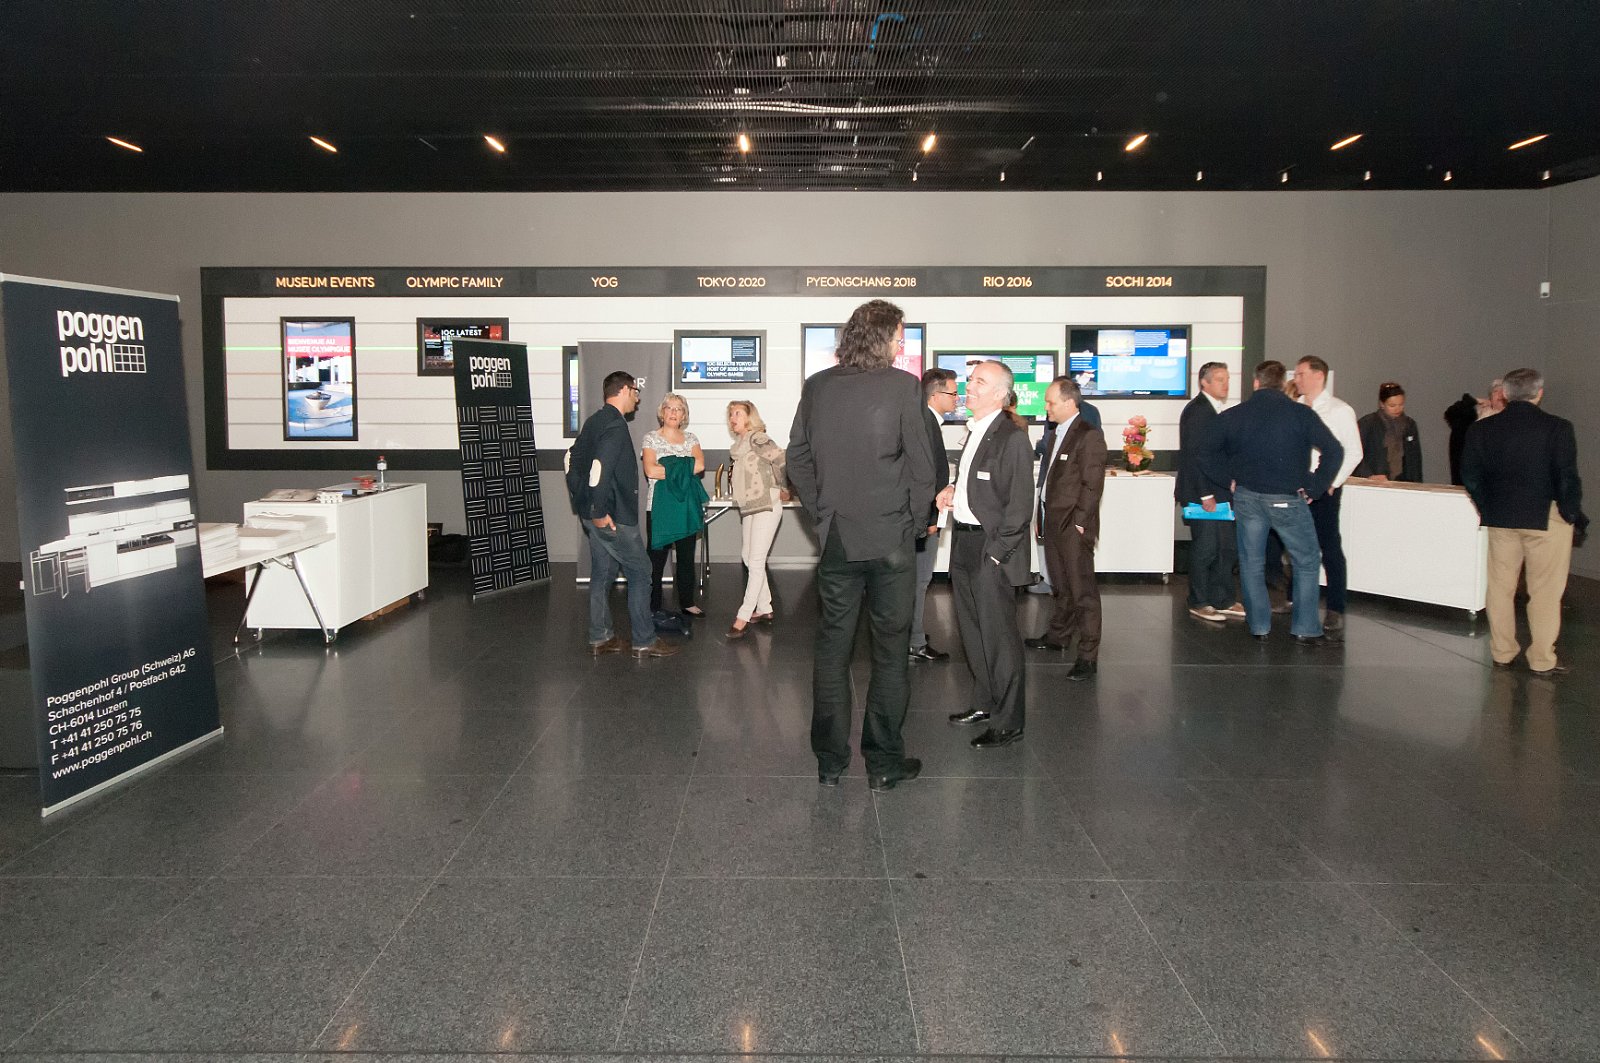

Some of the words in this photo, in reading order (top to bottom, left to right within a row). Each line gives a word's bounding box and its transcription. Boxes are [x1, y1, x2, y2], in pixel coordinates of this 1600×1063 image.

[276, 276, 328, 288] MUSEUM
[330, 276, 376, 288] EVENTS
[406, 276, 460, 288] OLYMPIC
[462, 276, 504, 288] FAMILY
[591, 276, 618, 288] YOG
[697, 276, 736, 288] TOKYO
[738, 276, 766, 288] 2020
[806, 276, 892, 288] PYEONGCHANG
[893, 276, 916, 288] 2018
[983, 276, 1005, 288] RIO
[1006, 276, 1032, 288] 2016
[1106, 276, 1144, 288] SOCHI
[1146, 276, 1172, 288] 2014
[57, 310, 144, 344] poggen
[60, 342, 114, 378] pohl
[469, 356, 511, 372] poggen
[471, 372, 497, 390] pohl
[47, 678, 108, 706] Poggenpohl
[111, 669, 139, 684] Group
[142, 653, 181, 675] (Schweiz)
[183, 648, 196, 659] AG
[48, 690, 115, 721] Schachenhof
[116, 686, 122, 695] 4
[124, 685, 127, 694] /
[130, 671, 168, 691] Postfach
[170, 664, 186, 676] 642
[49, 711, 94, 735] CH-6014
[97, 700, 128, 718] Luzern
[50, 740, 57, 749] T
[61, 731, 78, 745] +41
[81, 727, 91, 738] 41
[94, 719, 113, 734] 250
[116, 714, 127, 728] 75
[129, 707, 142, 718] 75
[51, 754, 59, 765] F
[62, 746, 78, 758] +41
[81, 740, 92, 752] 41
[95, 732, 114, 747] 250
[116, 726, 128, 738] 75
[130, 720, 142, 732] 76
[52, 730, 152, 779] www.poggenpohl.ch
